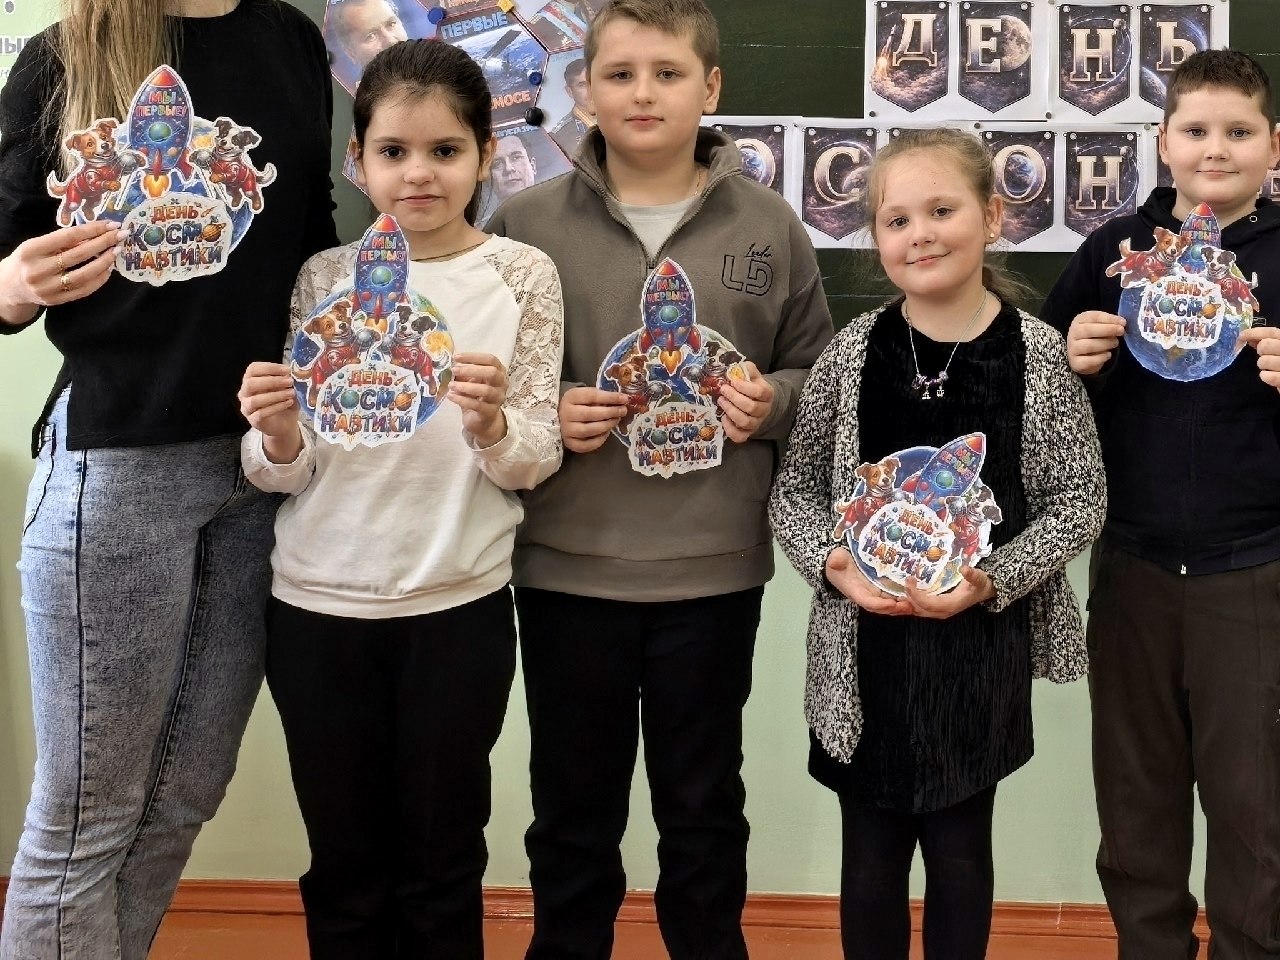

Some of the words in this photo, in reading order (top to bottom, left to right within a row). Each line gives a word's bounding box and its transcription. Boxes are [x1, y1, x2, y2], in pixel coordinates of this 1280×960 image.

[441, 12, 508, 39] ПЕРВЫЕ
[894, 14, 1197, 83] ДЕНЬ
[149, 91, 177, 105] МЫ
[152, 204, 199, 224] ДЕНЬ
[371, 236, 397, 249] МЫ
[657, 279, 680, 291] МЫ
[1165, 281, 1202, 297] ДЕНЬ
[348, 370, 393, 386] ДЕНЬ
[655, 410, 695, 427] ДЕНЬ
